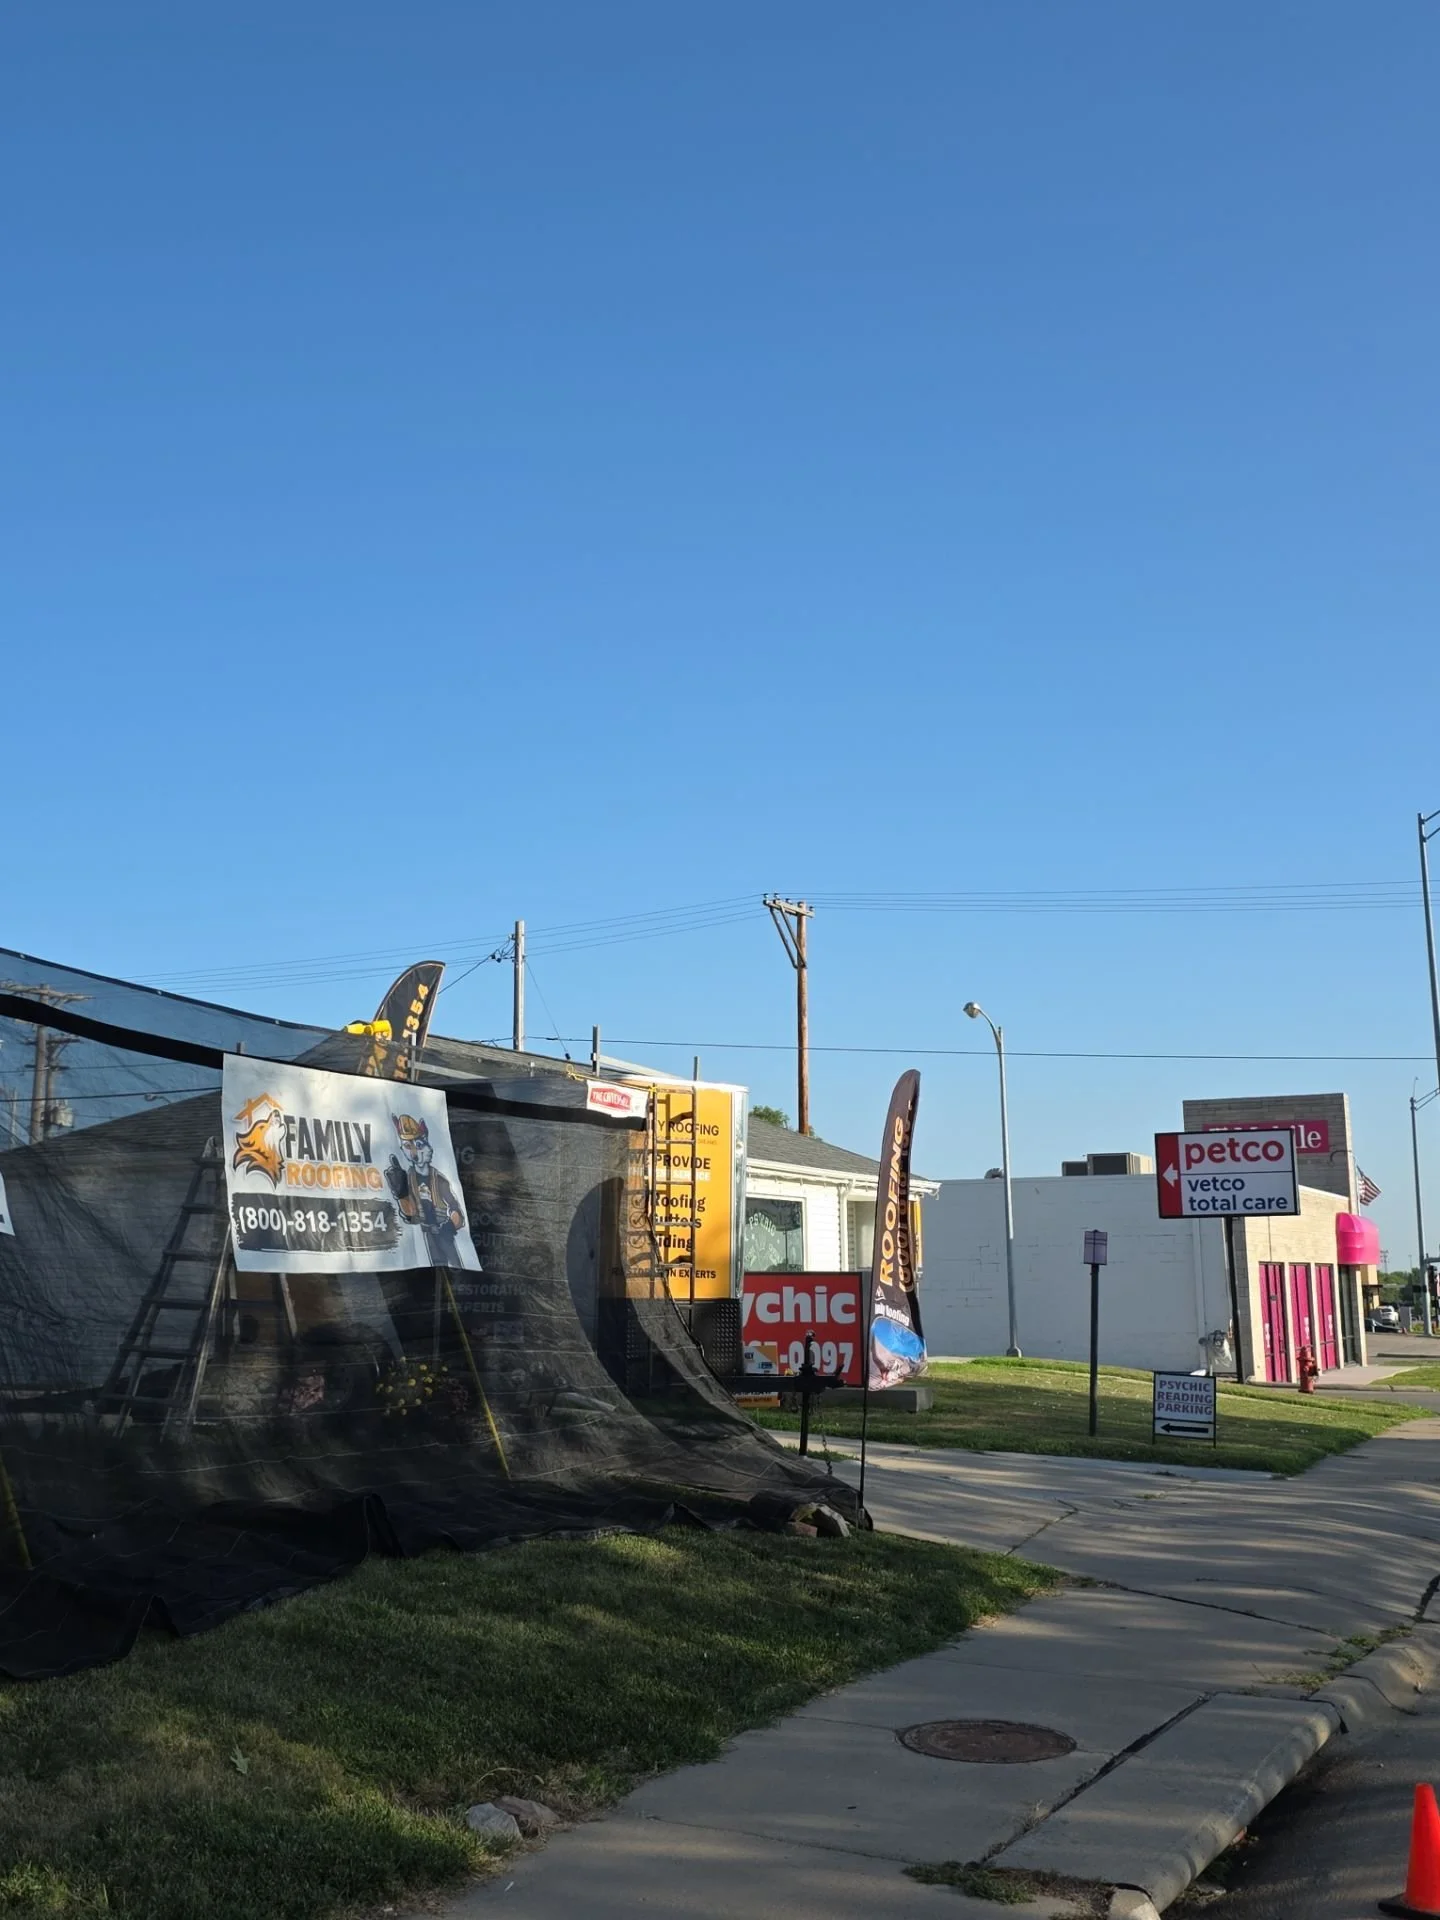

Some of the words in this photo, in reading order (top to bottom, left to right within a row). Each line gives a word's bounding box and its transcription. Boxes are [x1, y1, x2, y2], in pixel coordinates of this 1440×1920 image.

[283, 1115, 372, 1163] FAMILY
[1184, 1137, 1285, 1171] petco
[286, 1163, 384, 1190] ROOFING
[1187, 1178, 1245, 1192] vetco
[879, 1116, 904, 1287] ROOFING
[1189, 1195, 1237, 1211] total
[1242, 1197, 1288, 1210] care
[239, 1206, 387, 1235] (800)-818-1354
[657, 1234, 694, 1252] iding
[679, 1268, 717, 1279] EXERTS
[1160, 1380, 1211, 1392] PSYCHIC
[1157, 1391, 1213, 1404] READING
[1157, 1402, 1213, 1415] PARKING
